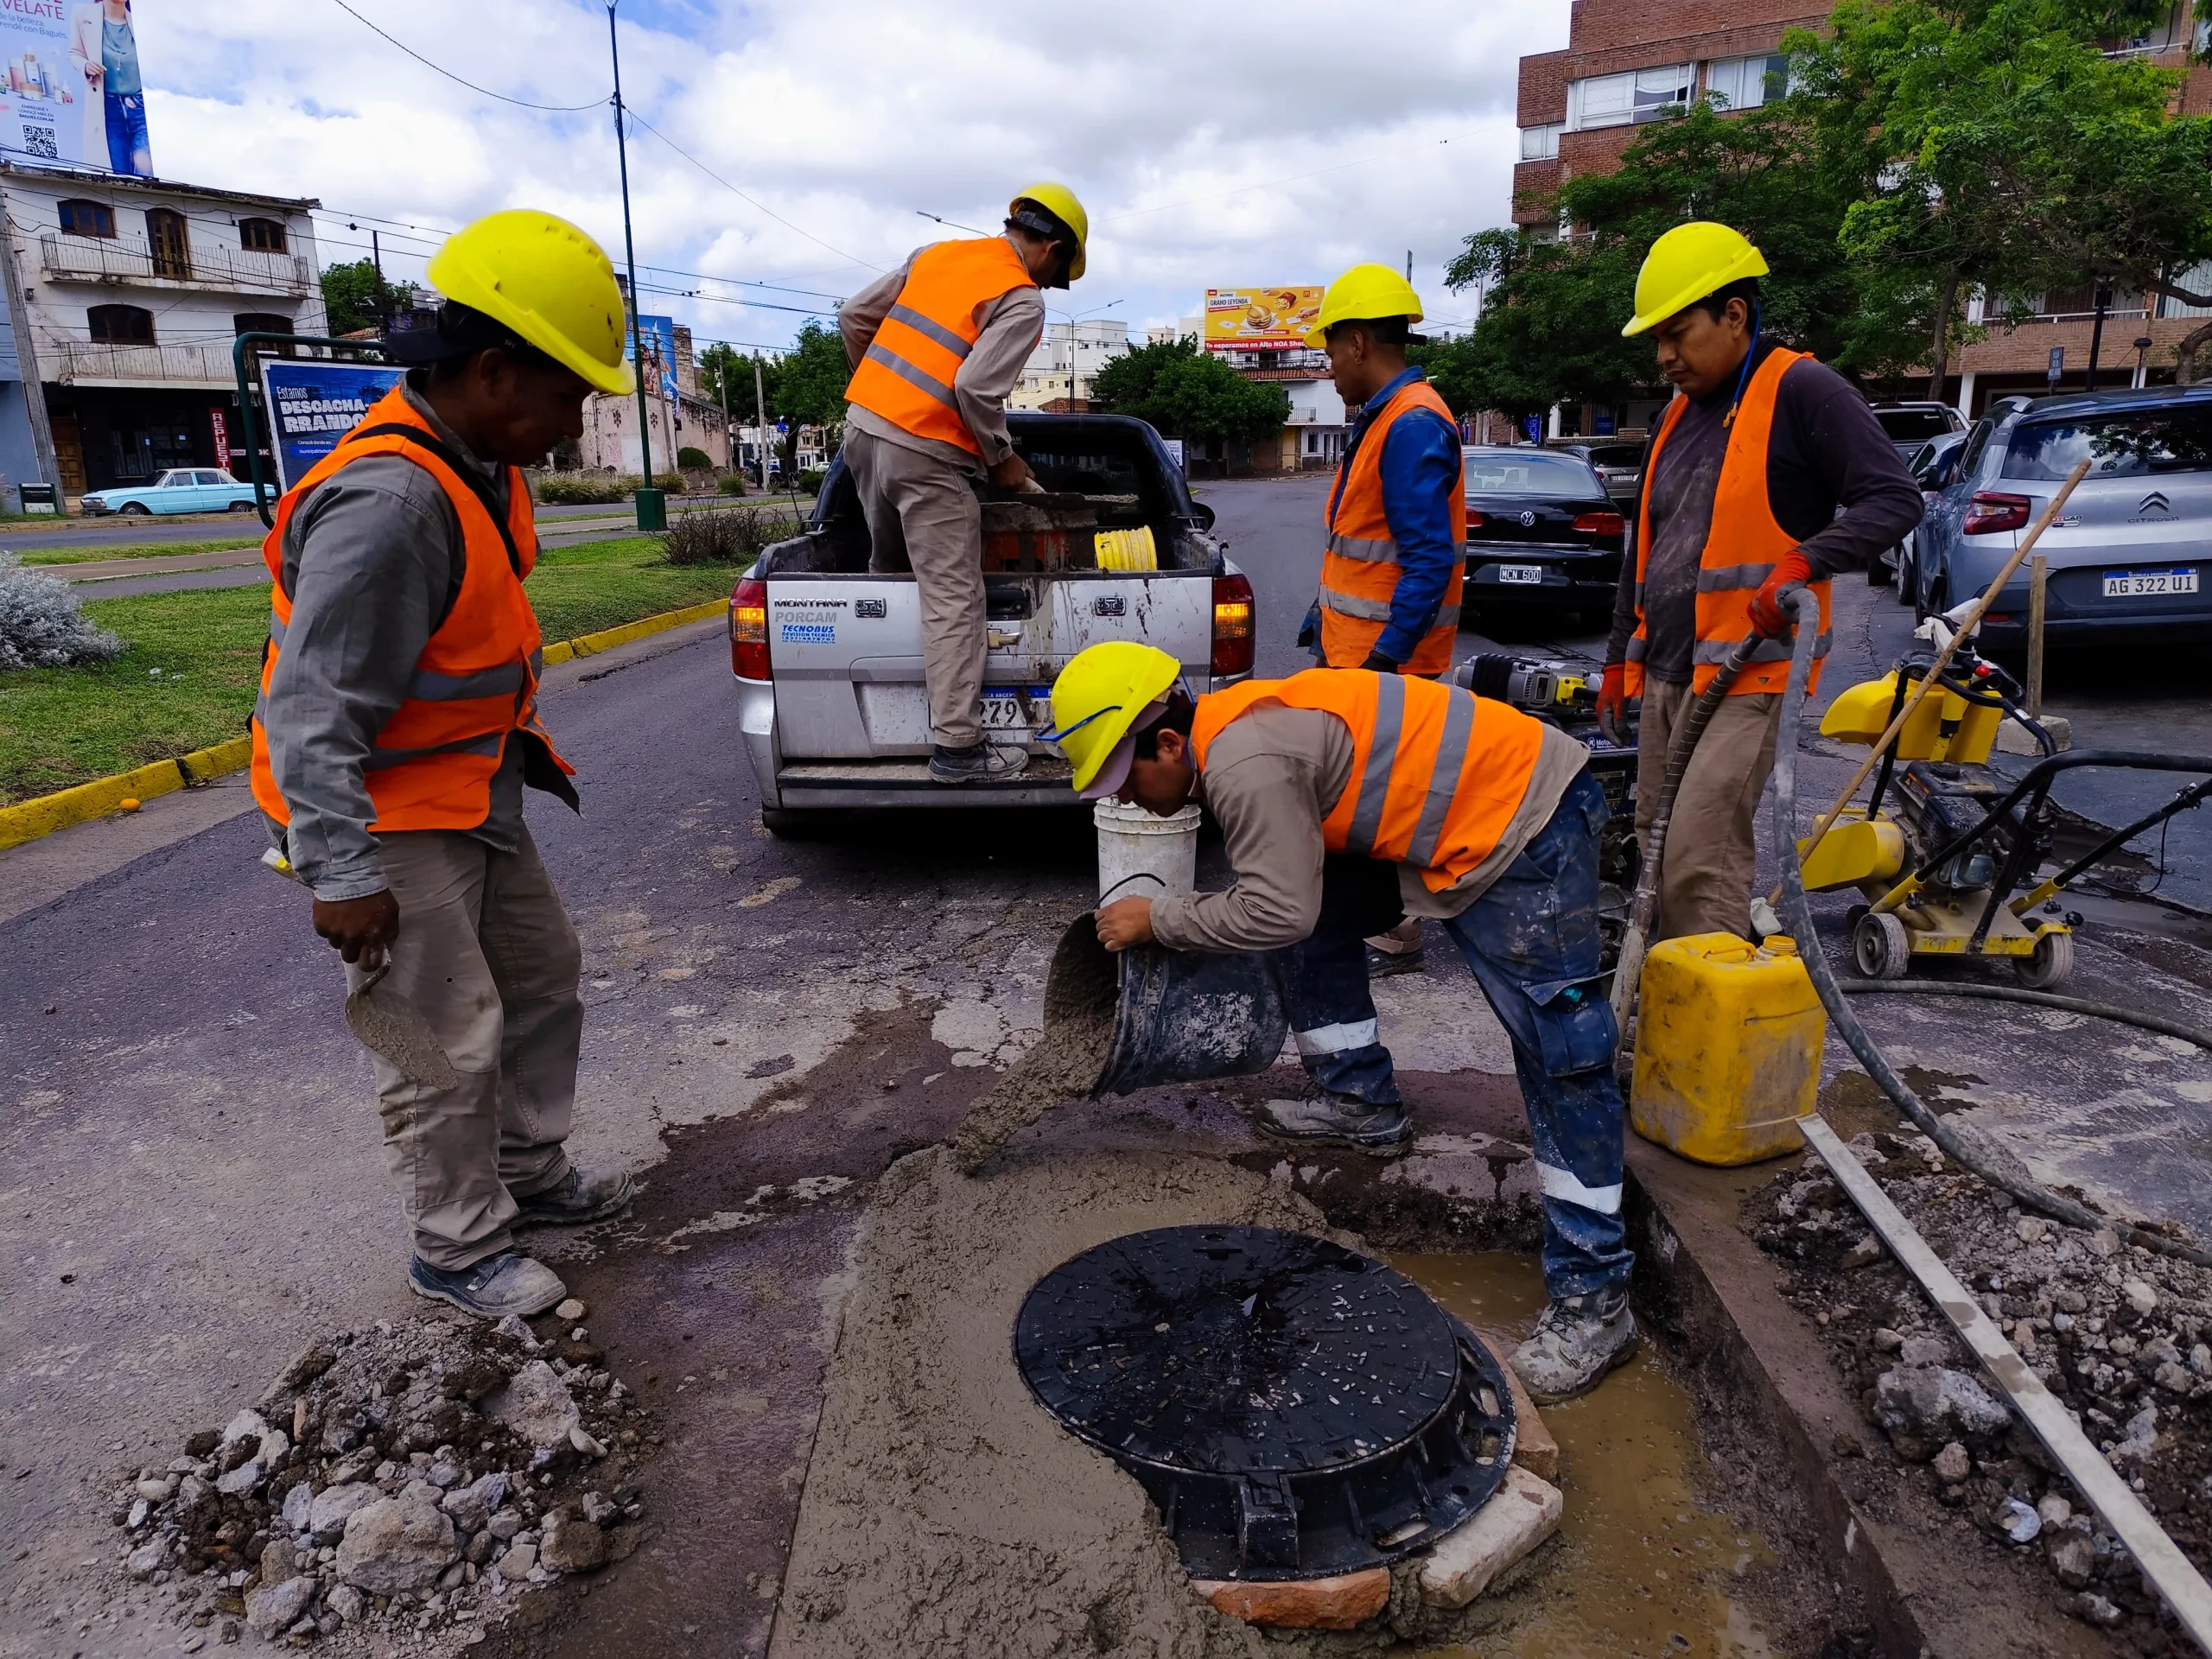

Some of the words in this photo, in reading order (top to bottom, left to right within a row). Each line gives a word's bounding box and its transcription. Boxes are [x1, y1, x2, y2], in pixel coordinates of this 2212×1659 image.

[0, 0, 65, 21] VELATE
[17, 16, 46, 28] belleza.
[39, 27, 69, 40] Bagués.
[276, 386, 308, 400] Estamos
[1502, 570, 1518, 580] MCN
[1522, 570, 1539, 581] 600
[2108, 579, 2129, 594] AG
[2134, 577, 2166, 593] 322
[2172, 575, 2193, 591] UI
[773, 597, 848, 607] MONTANA
[775, 612, 837, 623] PORCAM
[783, 625, 835, 633] TECNOBUS
